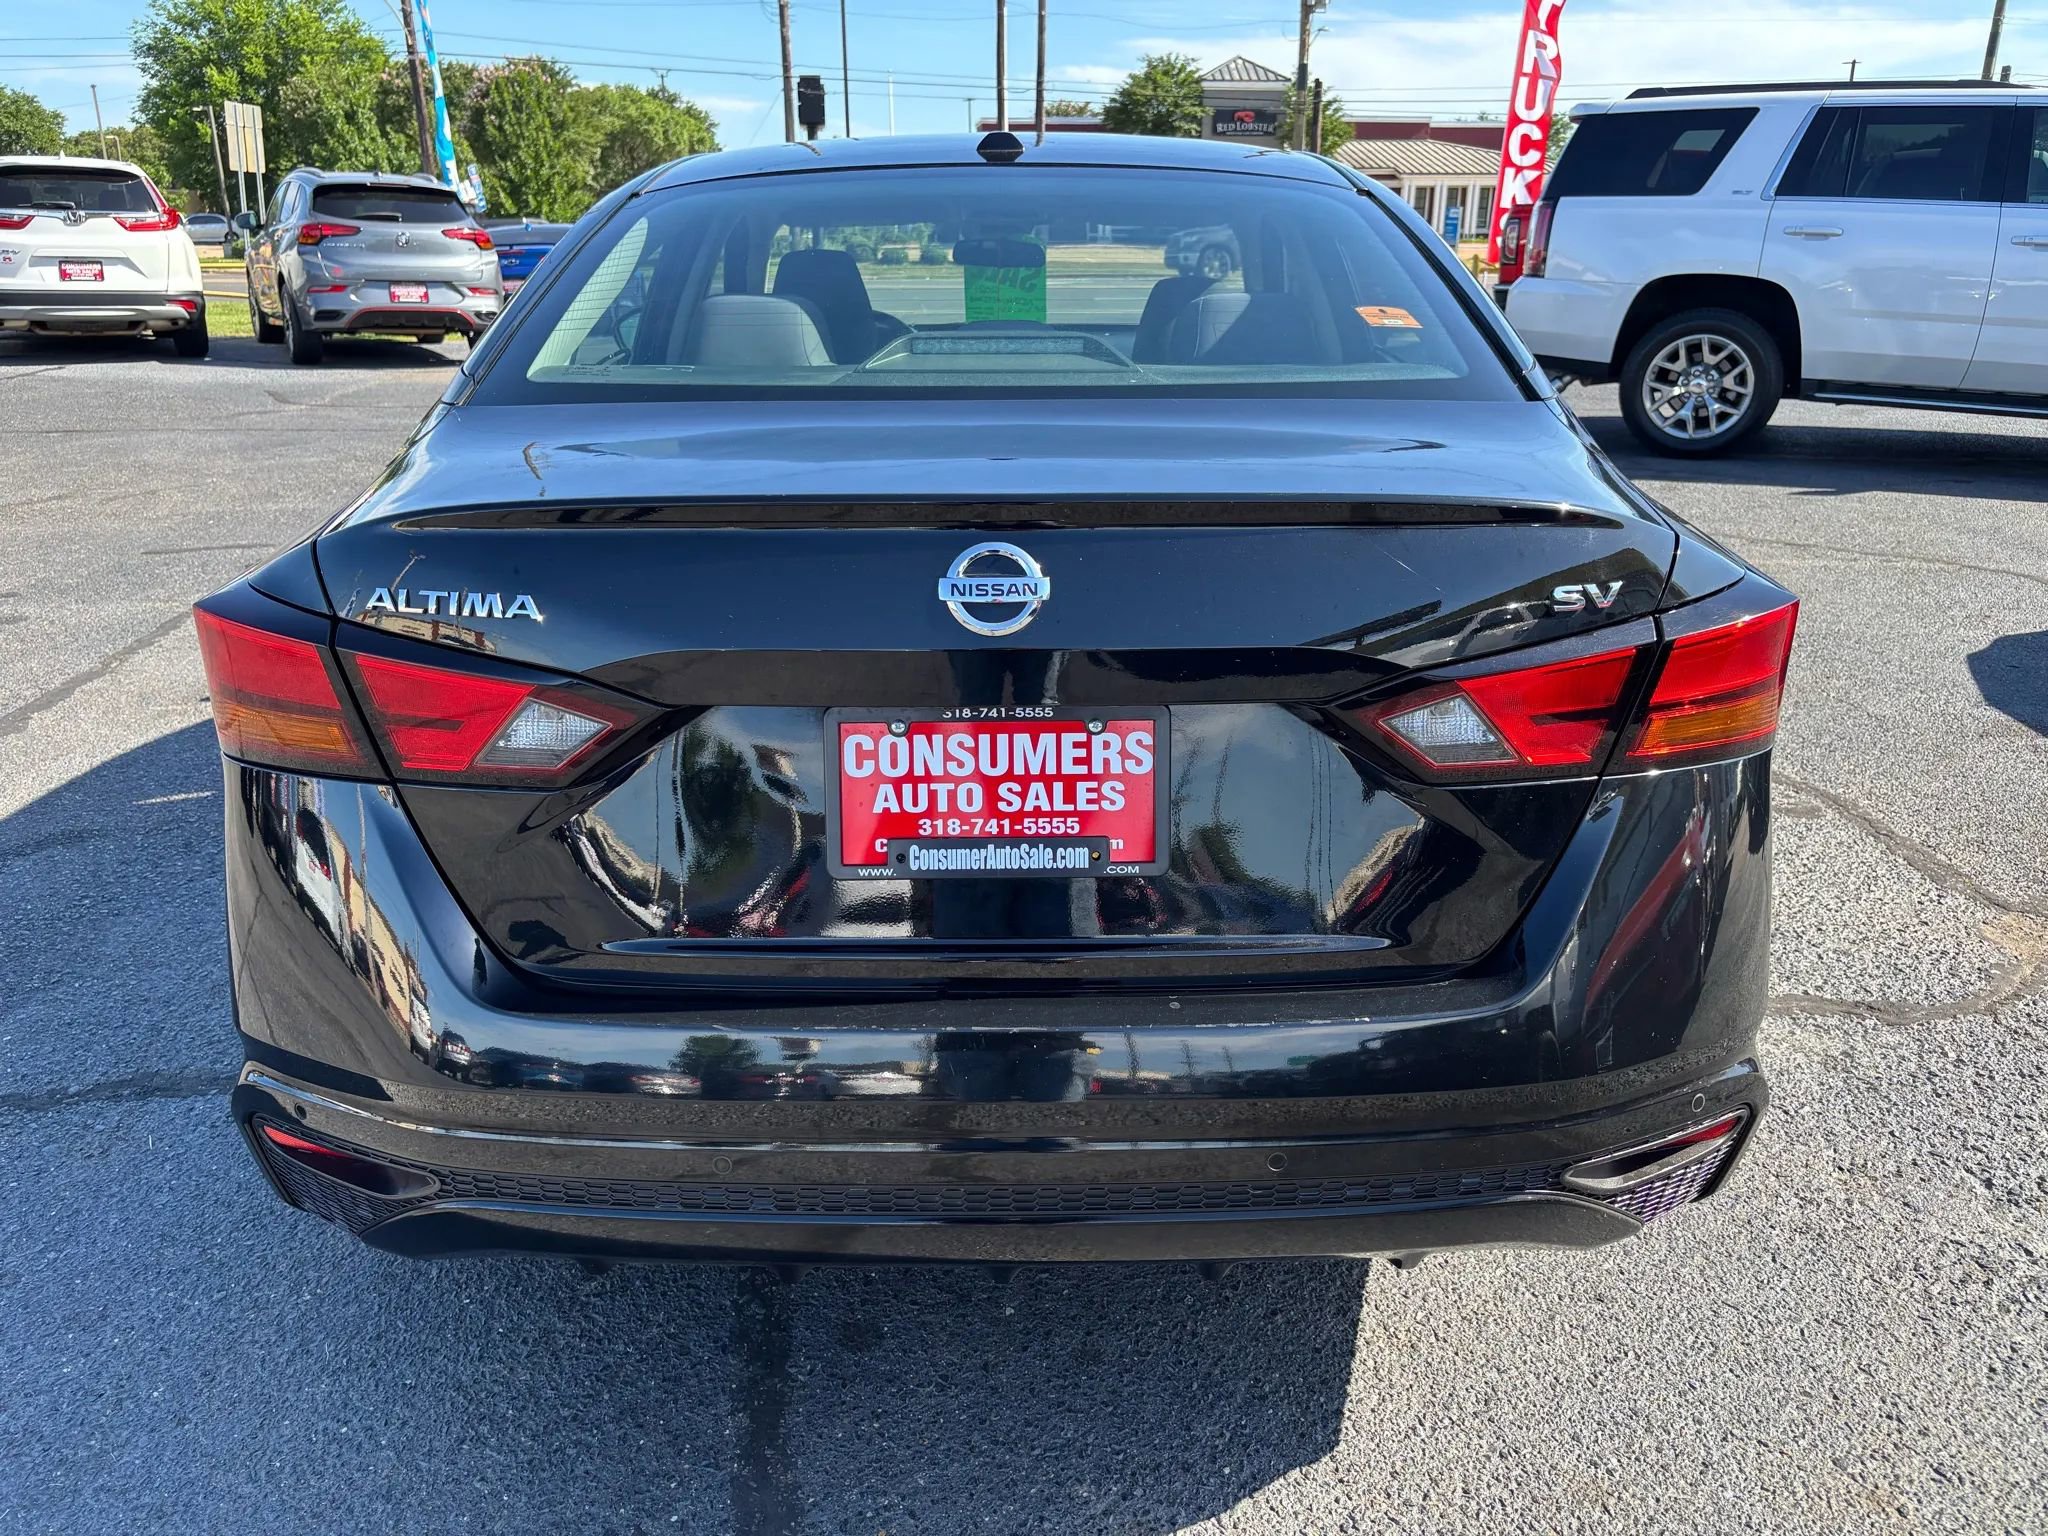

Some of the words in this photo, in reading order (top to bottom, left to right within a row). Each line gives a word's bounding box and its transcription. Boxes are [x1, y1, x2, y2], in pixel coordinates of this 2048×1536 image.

[1216, 123, 1235, 133] RED
[1236, 121, 1274, 133] LOBSTER
[1496, 0, 1562, 248] TRUCK
[950, 583, 1038, 597] NISSAN
[1552, 580, 1624, 612] SV
[364, 587, 544, 624] ALTIMA
[942, 707, 1054, 719] 318-741-5555
[843, 731, 1154, 778] CONSUMERS
[872, 782, 983, 814] AUTO
[997, 780, 1126, 812] SALES
[918, 817, 1080, 836] 318-741-5555
[909, 843, 1089, 871] ConsumerAutoSale.com
[1103, 865, 1140, 874] .COM
